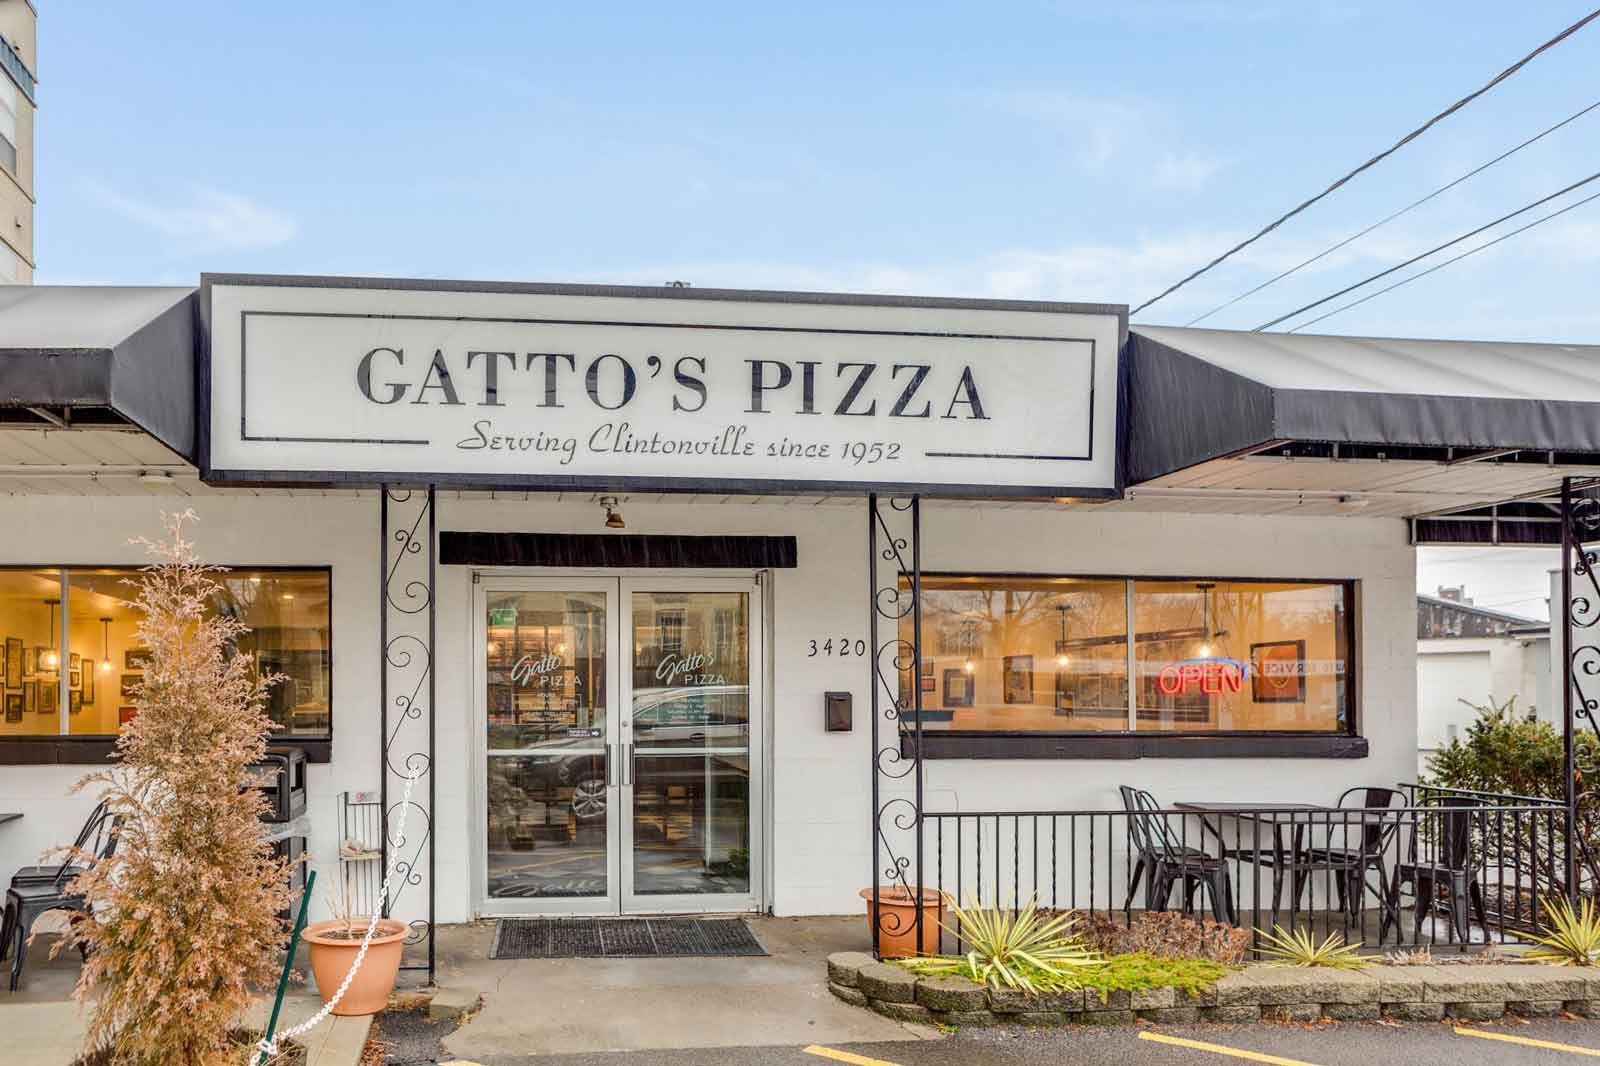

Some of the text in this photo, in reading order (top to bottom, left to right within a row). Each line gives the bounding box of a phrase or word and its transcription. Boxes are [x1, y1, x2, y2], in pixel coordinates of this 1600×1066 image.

[357, 347, 992, 420] GATTO'S PIZZA
[456, 420, 902, 466] Serving Clintonville since 1952
[807, 637, 866, 658] 3420
[540, 674, 583, 688] PIZZA
[684, 673, 726, 687] PIZZA
[1159, 664, 1244, 695] OPEN
